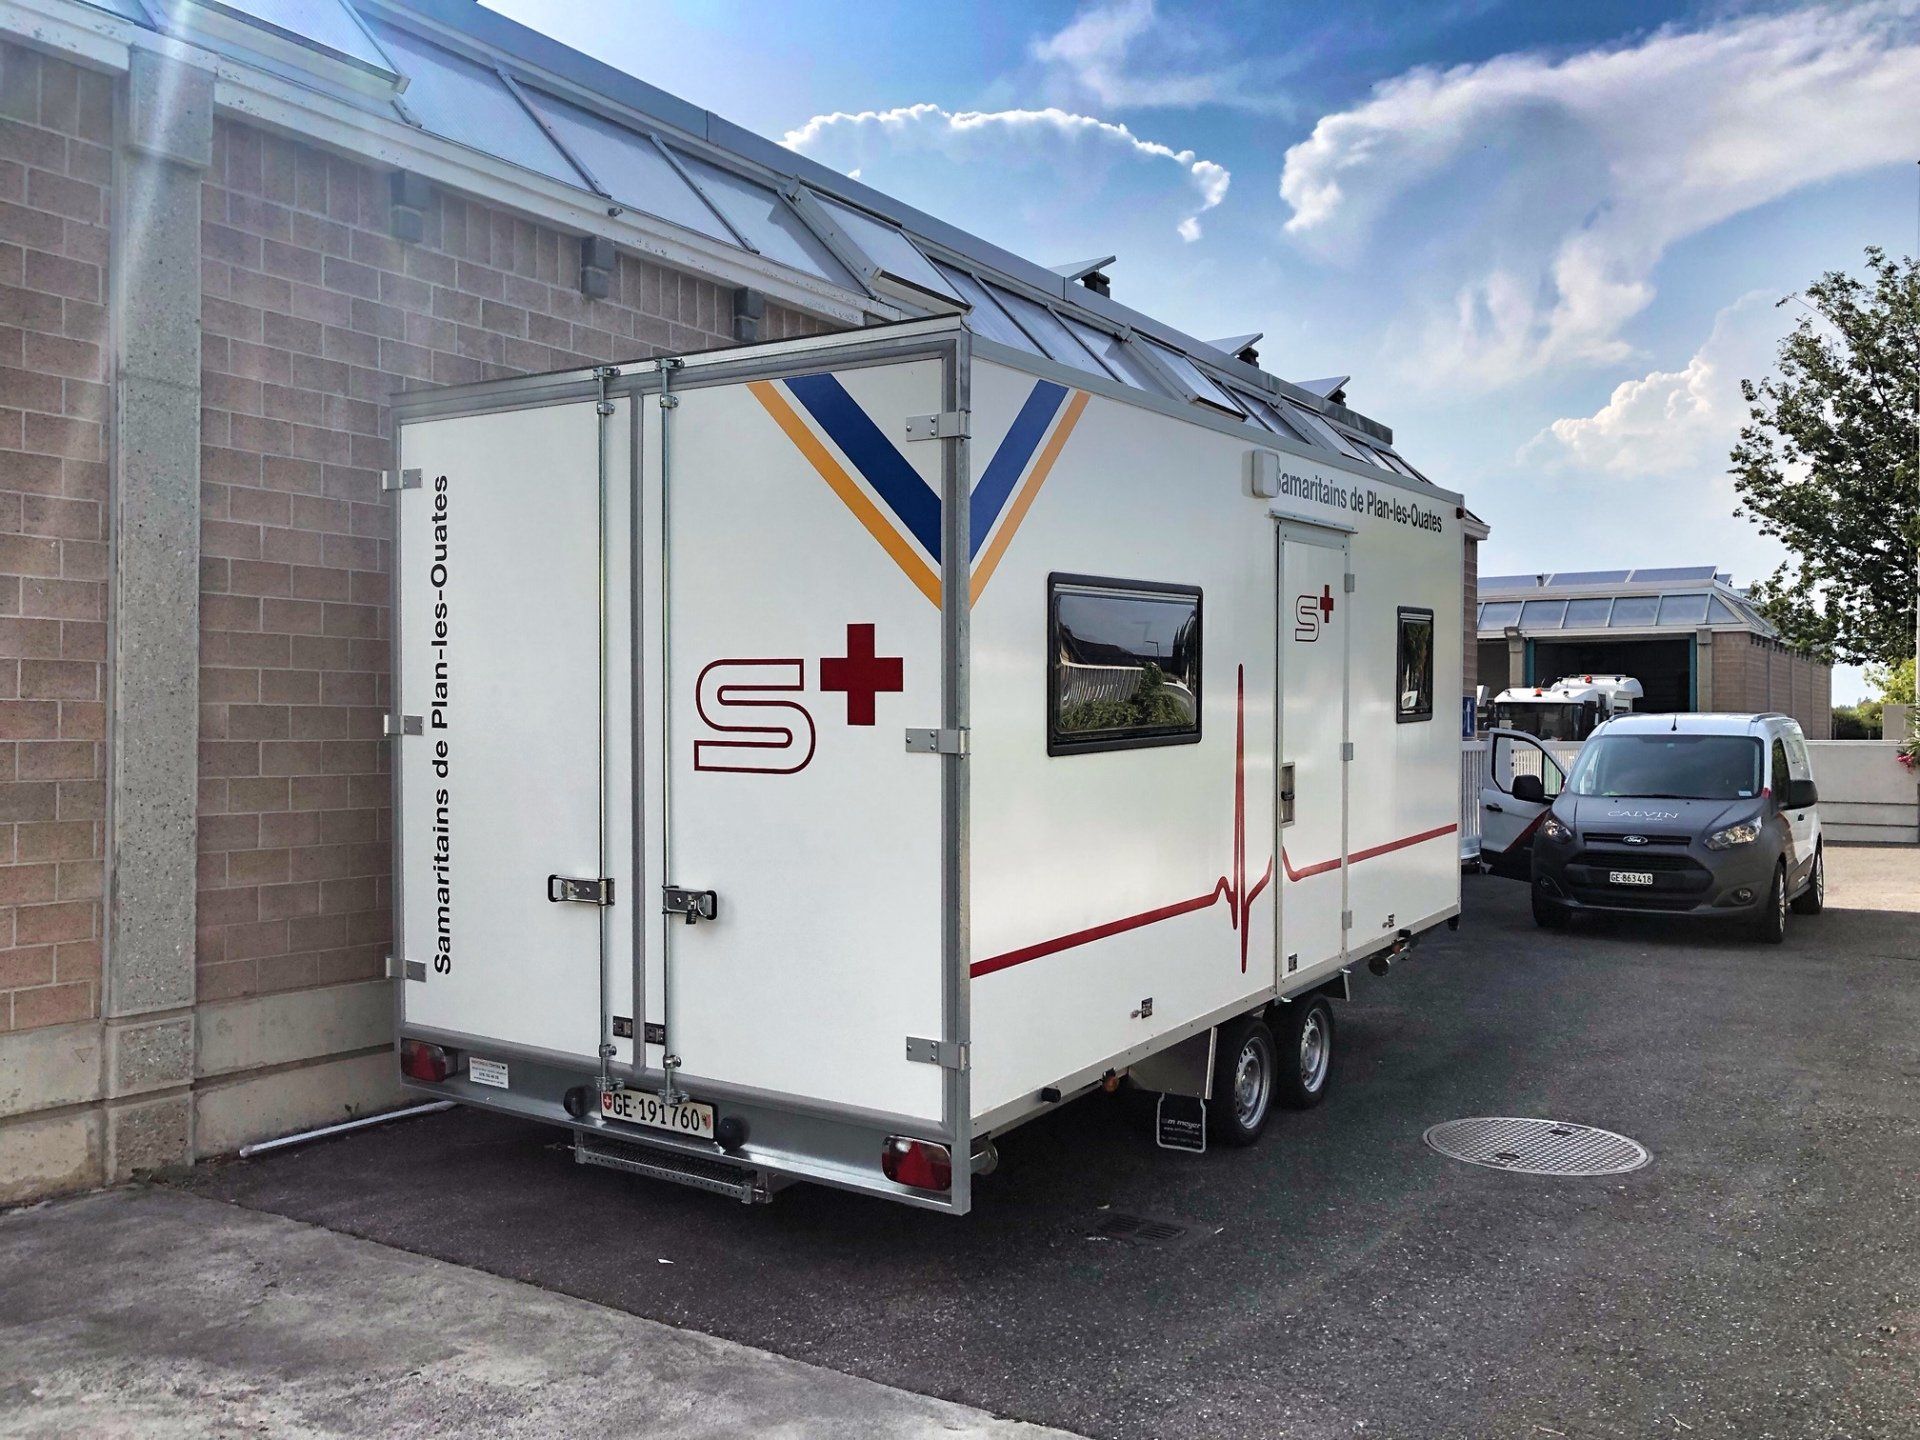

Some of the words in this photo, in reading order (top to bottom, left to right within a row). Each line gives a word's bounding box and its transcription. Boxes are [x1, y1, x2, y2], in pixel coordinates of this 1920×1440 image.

[1350, 486, 1364, 513] de
[1367, 490, 1442, 533] Plan-les-Ouates
[430, 475, 448, 729] Plan-les-Ouates
[432, 740, 448, 779] de
[1607, 810, 1679, 819] CALVIN
[433, 788, 450, 975] Samaritains
